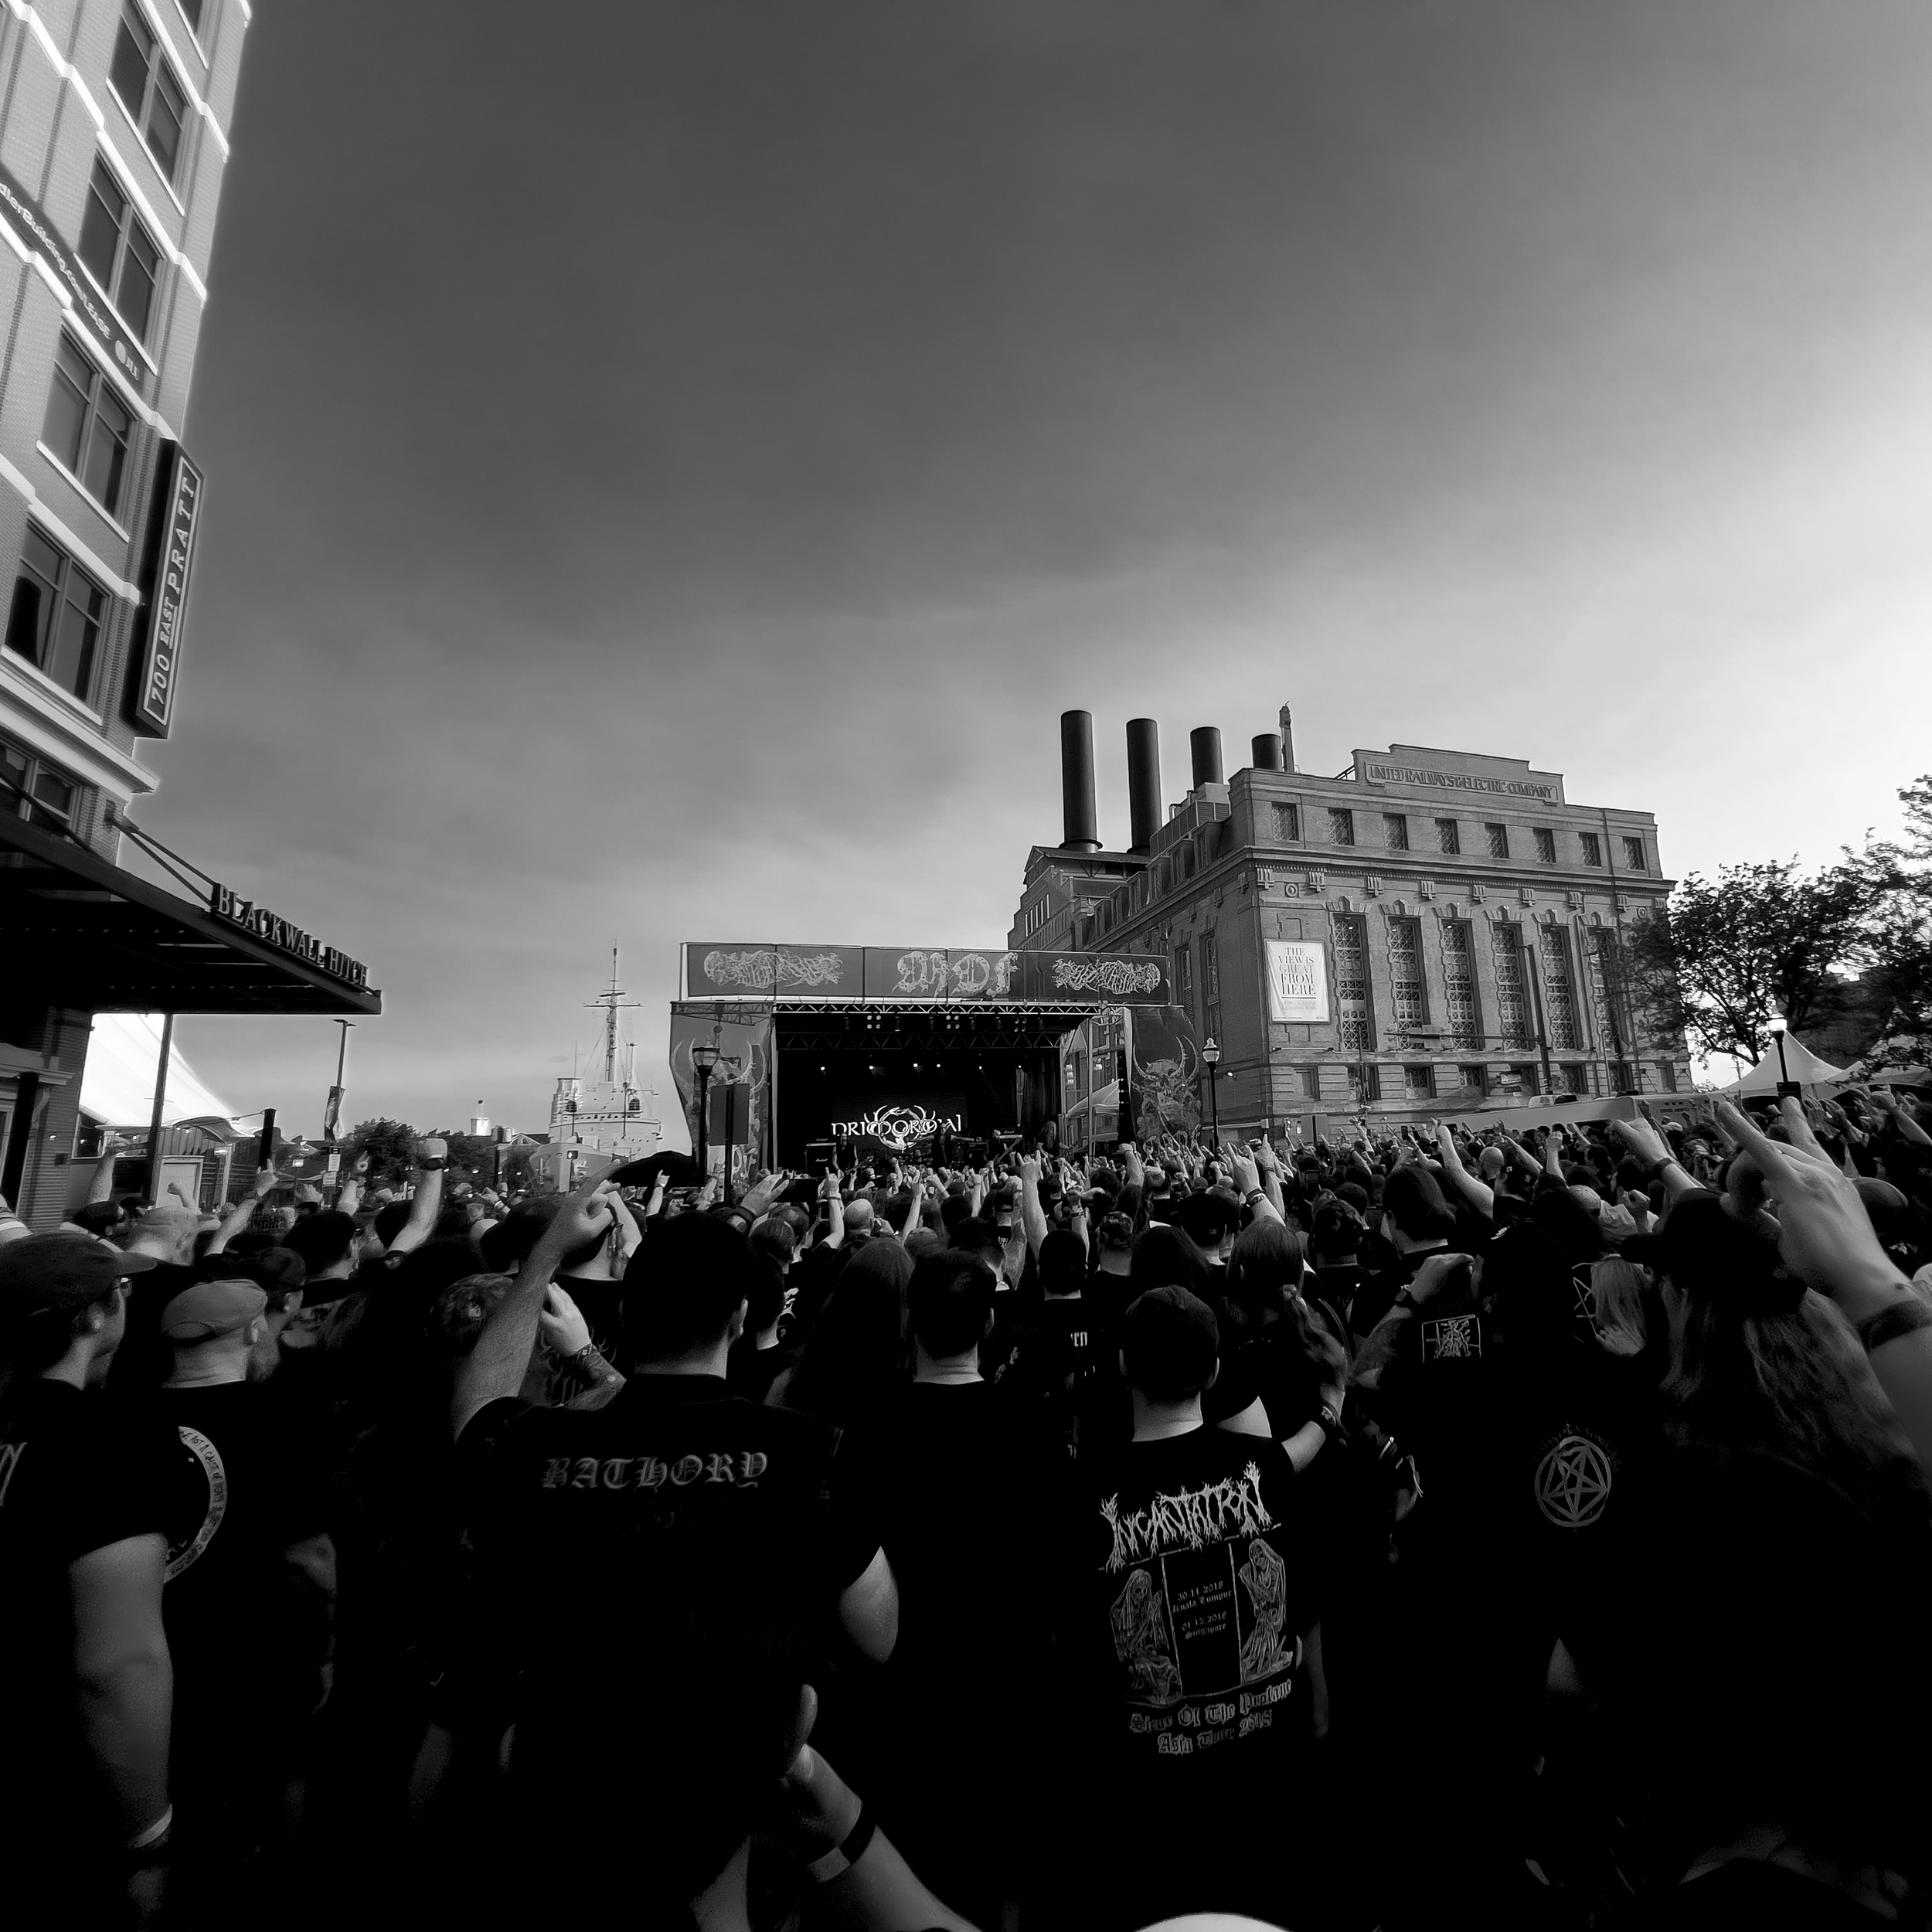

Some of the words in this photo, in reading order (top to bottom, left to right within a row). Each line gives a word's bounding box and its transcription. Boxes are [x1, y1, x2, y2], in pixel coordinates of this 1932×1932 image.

[167, 477, 194, 595] PRATT
[160, 596, 178, 647] EAST
[151, 653, 171, 706] 700
[1370, 765, 1404, 782] UNITED
[1406, 769, 1454, 787] RAILWAYS
[1464, 776, 1505, 794] ELECTRIC
[1508, 781, 1553, 799] COMPANY
[216, 883, 325, 964] BLACKWALL
[326, 946, 369, 986] HITCH
[1278, 955, 1302, 964] VIEW
[1305, 956, 1315, 964] IS
[1285, 947, 1305, 956] THE
[1279, 964, 1314, 973] GREAT
[1281, 973, 1314, 984] FROM
[1282, 984, 1316, 995] HERE
[541, 1451, 769, 1493] BATHORY
[1099, 1460, 1274, 1575] INCANTATION
[1172, 1600, 1197, 1614] Kuala
[1198, 1590, 1233, 1604] Lumpur
[1185, 1623, 1226, 1640] Singapore
[1178, 1704, 1201, 1727] Of
[1205, 1702, 1235, 1725] The
[1157, 1732, 1194, 1756] Asia
[1197, 1728, 1235, 1749] Tour
